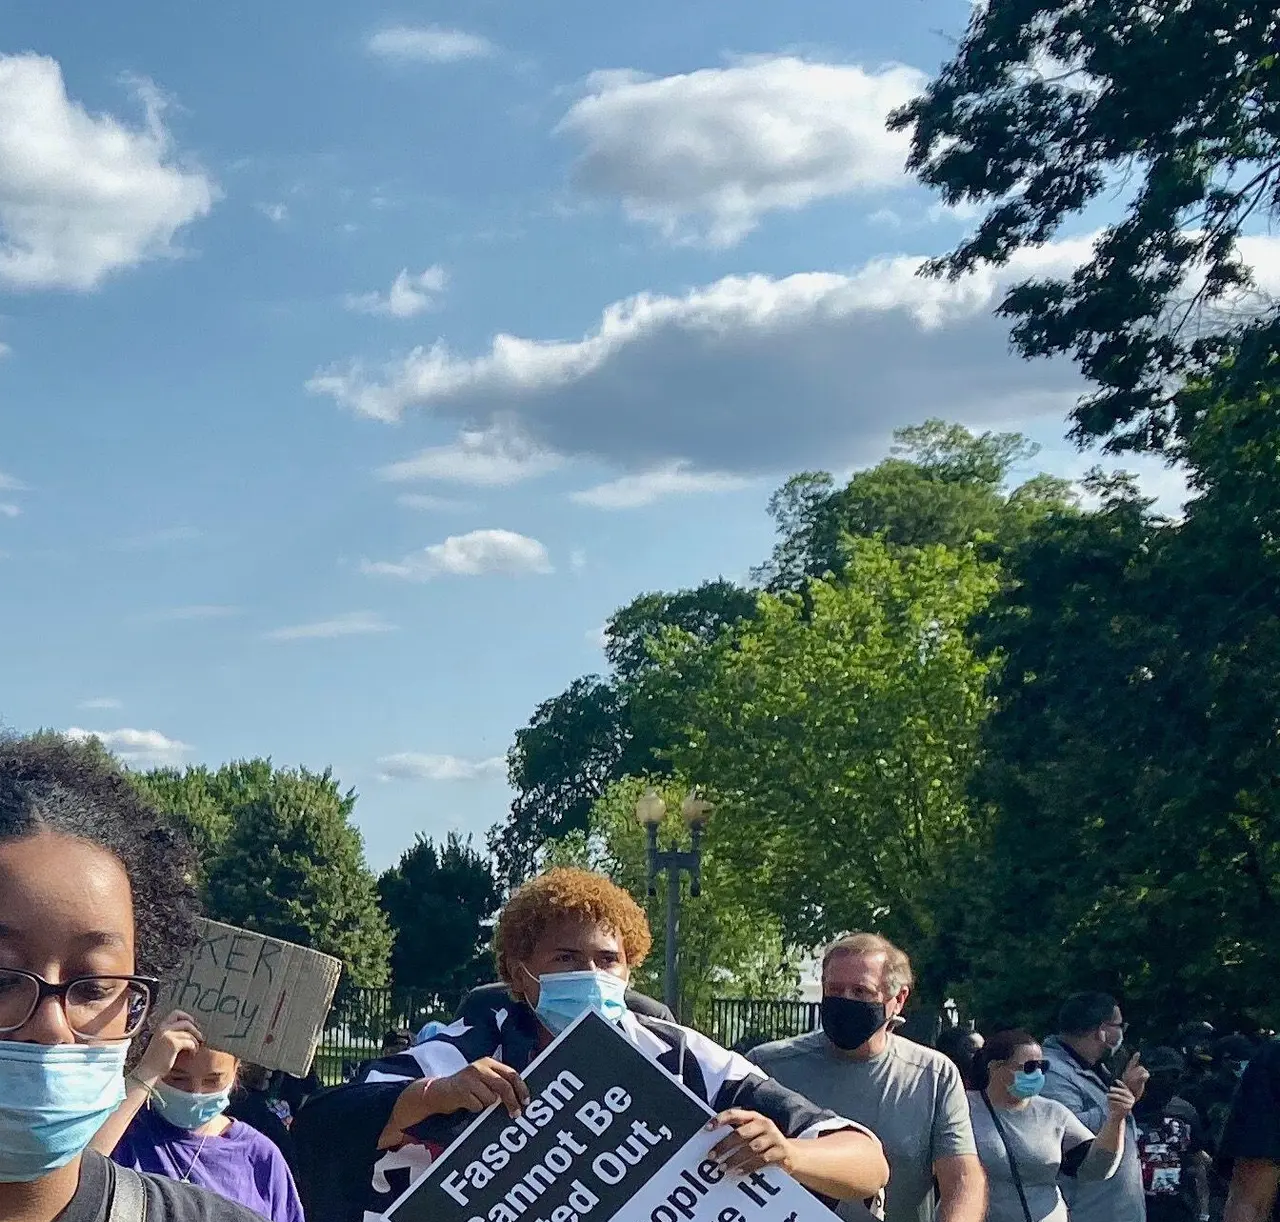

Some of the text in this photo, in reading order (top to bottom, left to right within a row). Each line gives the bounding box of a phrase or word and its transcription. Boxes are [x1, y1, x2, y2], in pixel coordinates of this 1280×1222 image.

[195, 932, 284, 985] KER
[575, 1086, 633, 1137] Be
[440, 1070, 585, 1207] Fascism
[591, 1119, 673, 1186] Out,
[737, 1169, 782, 1208] It
